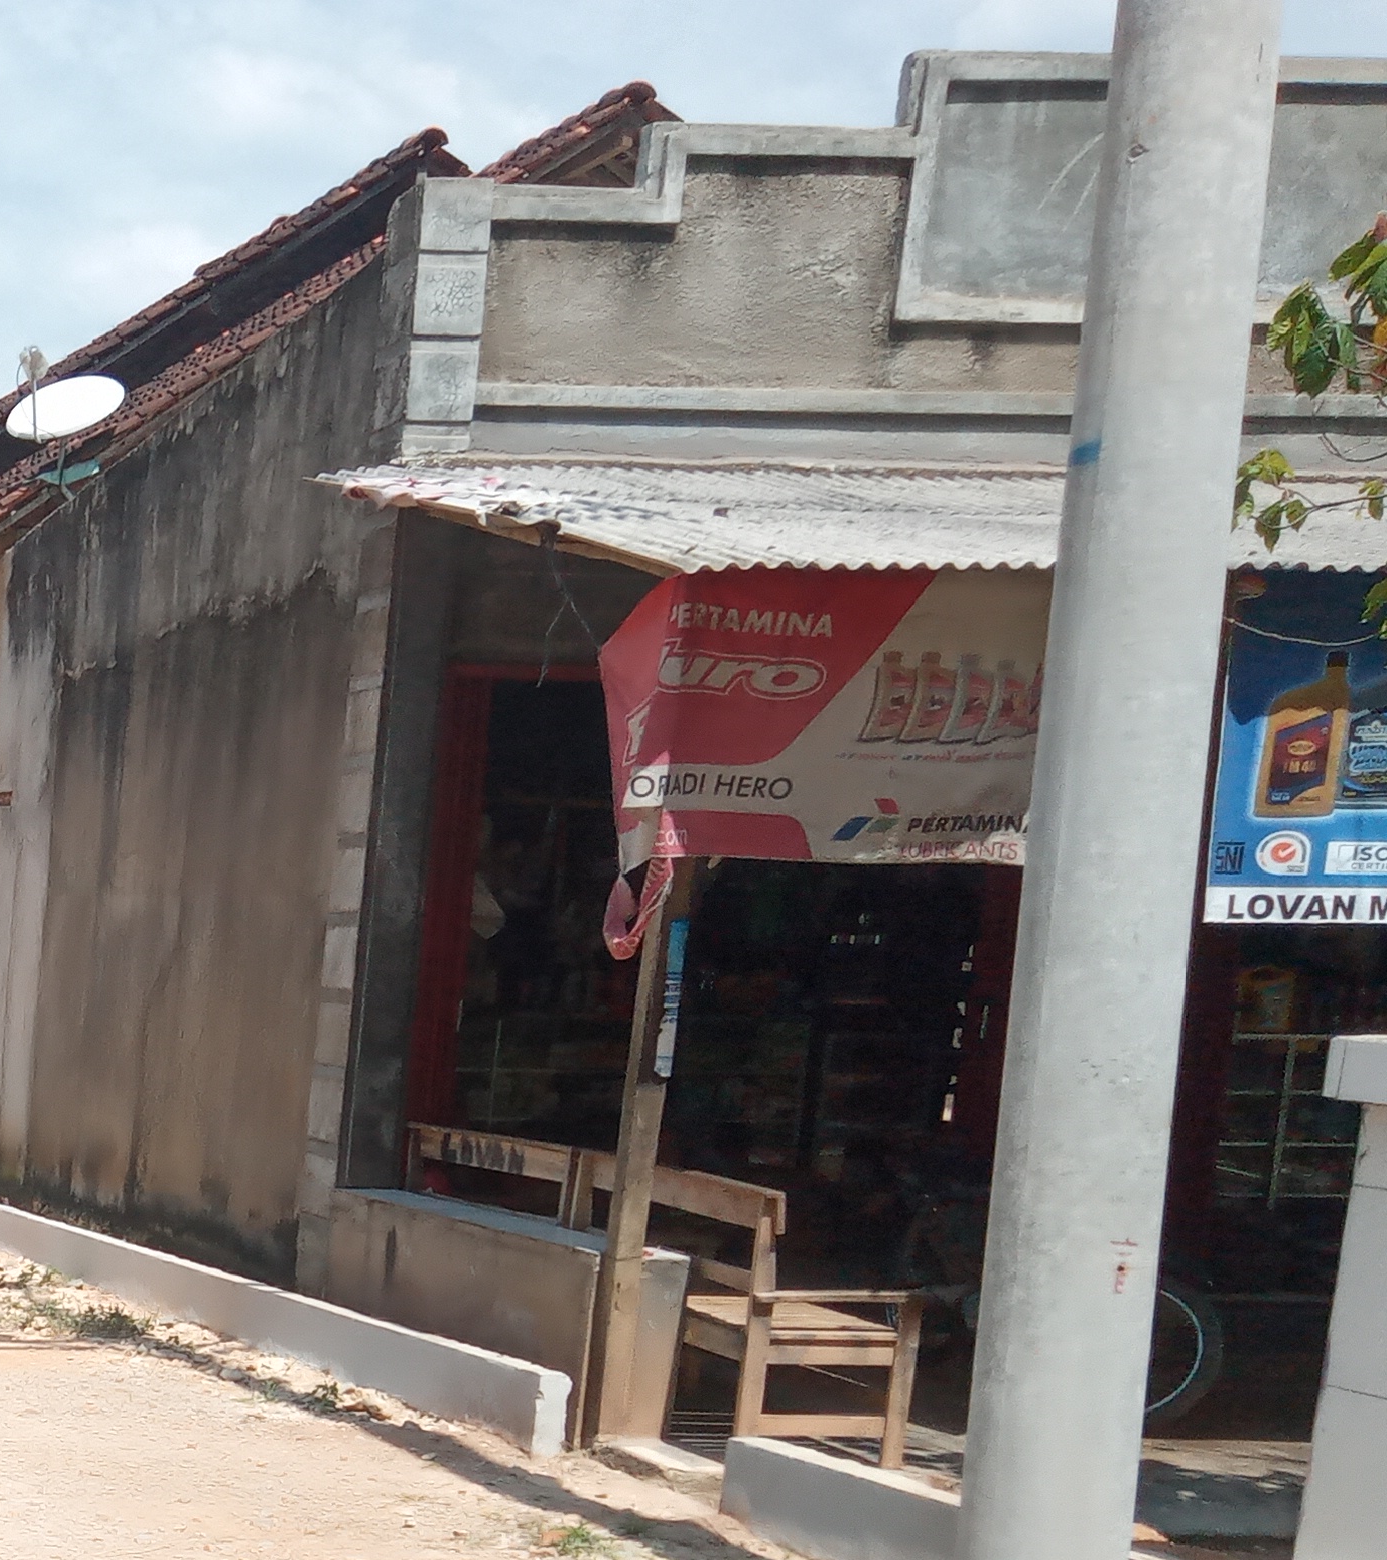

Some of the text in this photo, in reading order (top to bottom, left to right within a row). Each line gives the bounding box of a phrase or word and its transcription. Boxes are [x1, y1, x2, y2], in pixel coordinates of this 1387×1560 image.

[714, 774, 793, 800] HERO
[907, 814, 1028, 834] PERTAMIN
[898, 840, 1019, 861] LUBRICANTS
[1350, 861, 1387, 871] CERTI
[1227, 894, 1357, 920] LOVAN
